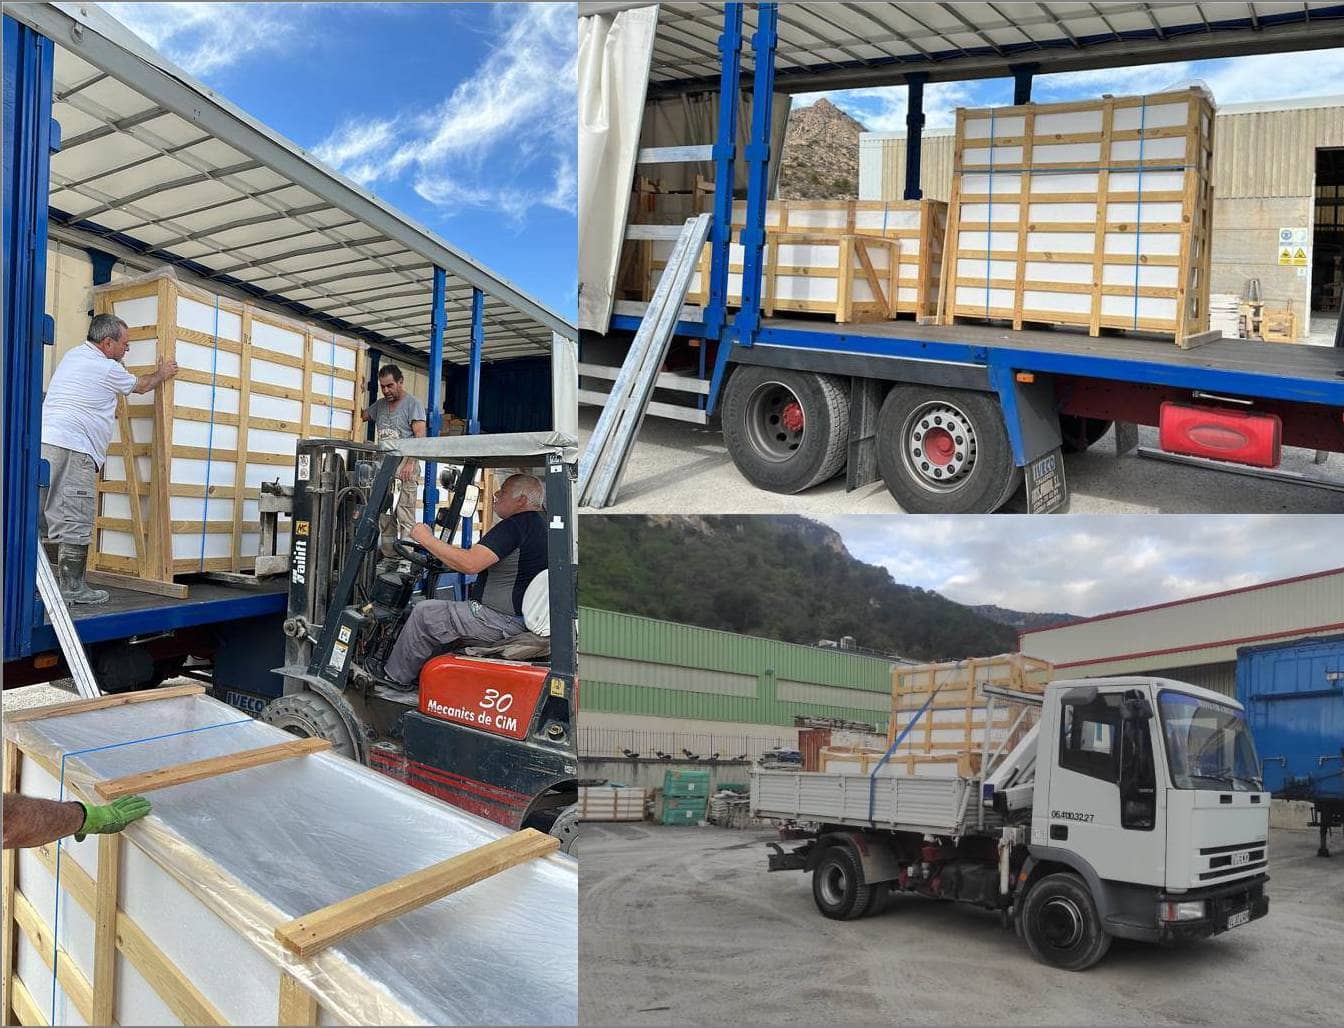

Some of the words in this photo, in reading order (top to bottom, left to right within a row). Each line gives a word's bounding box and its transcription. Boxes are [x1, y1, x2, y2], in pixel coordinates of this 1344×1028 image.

[1032, 454, 1057, 482] IVECO
[226, 691, 266, 713] IVECO
[479, 688, 514, 713] 30
[427, 699, 476, 722] Mecanics
[477, 711, 493, 726] de
[495, 715, 518, 732] CiM
